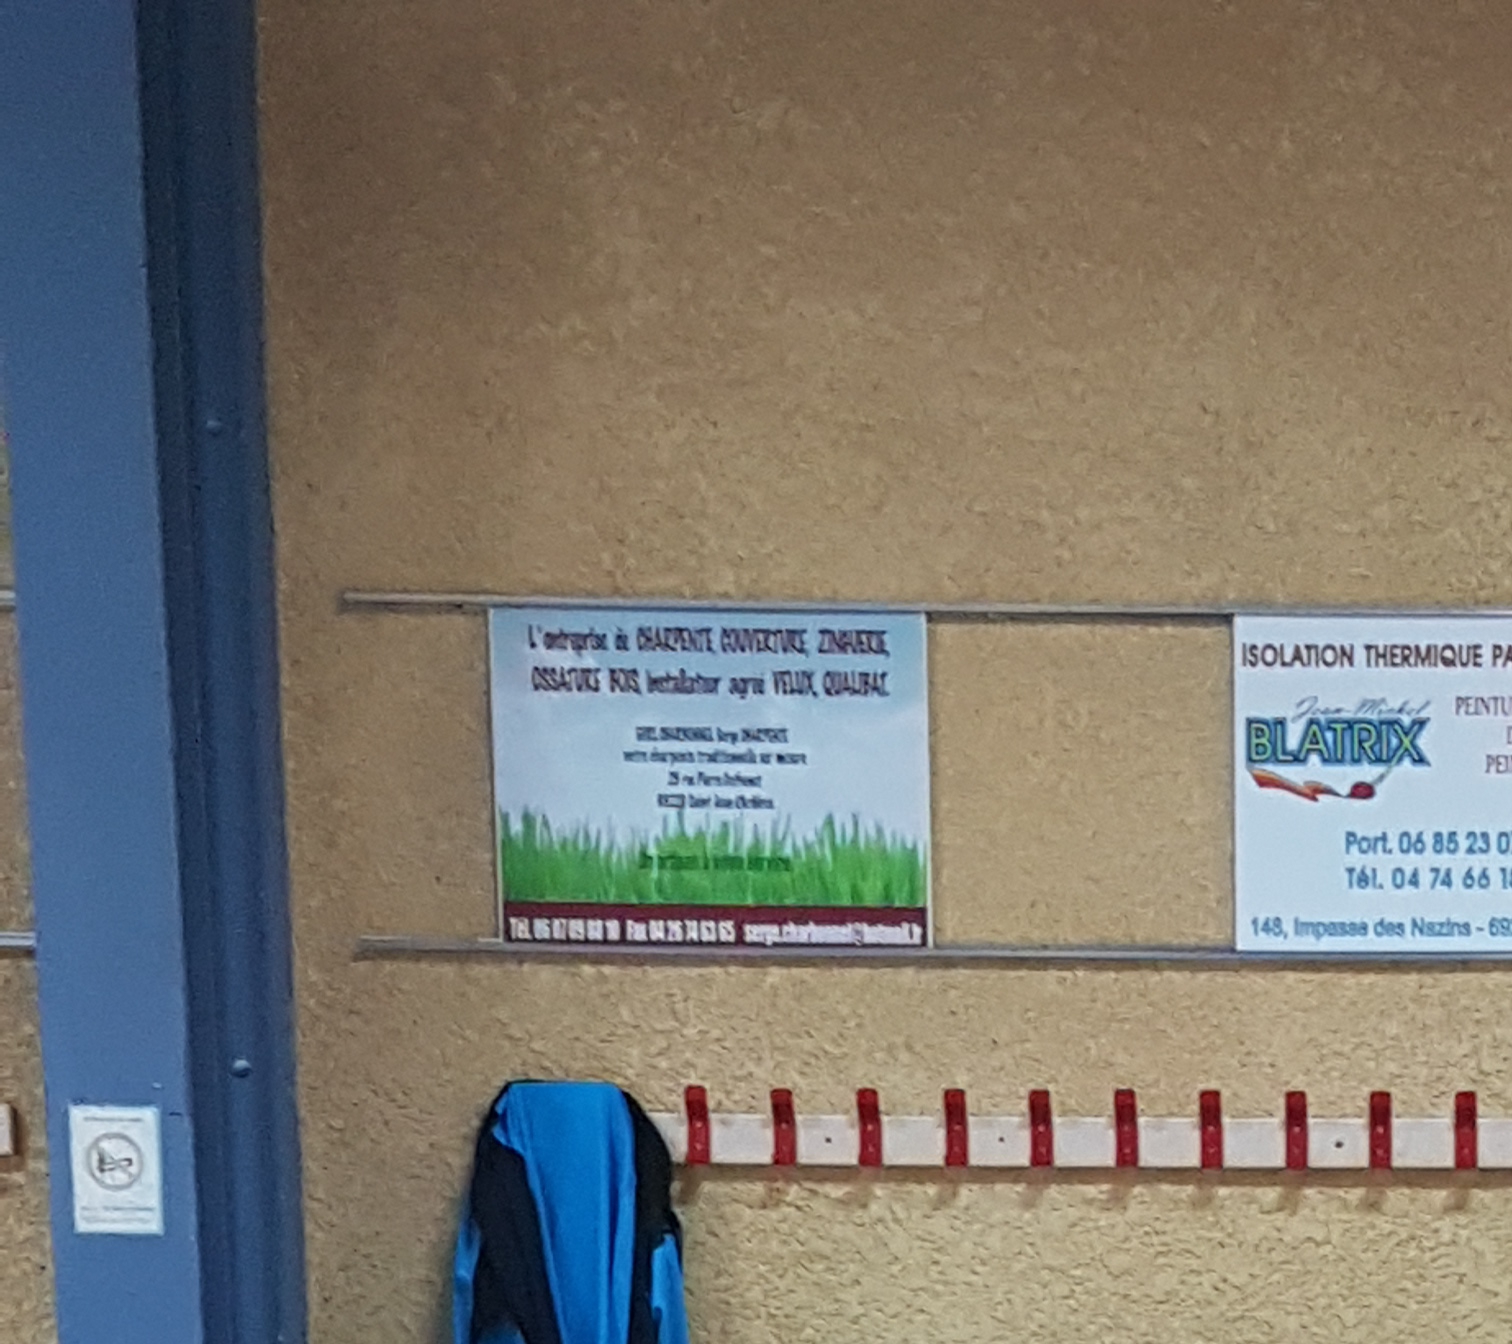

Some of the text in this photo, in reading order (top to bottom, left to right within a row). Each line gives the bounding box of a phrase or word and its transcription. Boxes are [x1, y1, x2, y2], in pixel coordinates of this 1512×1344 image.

[1242, 643, 1355, 668] ISOLATION
[1364, 643, 1483, 668] THERMIQUE
[1246, 716, 1431, 767] BLATRIX
[1345, 831, 1393, 855] Port.
[1398, 831, 1426, 855] 06
[1432, 831, 1459, 855] 85
[1465, 831, 1491, 855] 23
[1345, 866, 1384, 890] Tél.
[1391, 867, 1420, 889] 04
[1430, 867, 1453, 889] 74
[1462, 867, 1490, 889] 66
[1373, 916, 1405, 938] des
